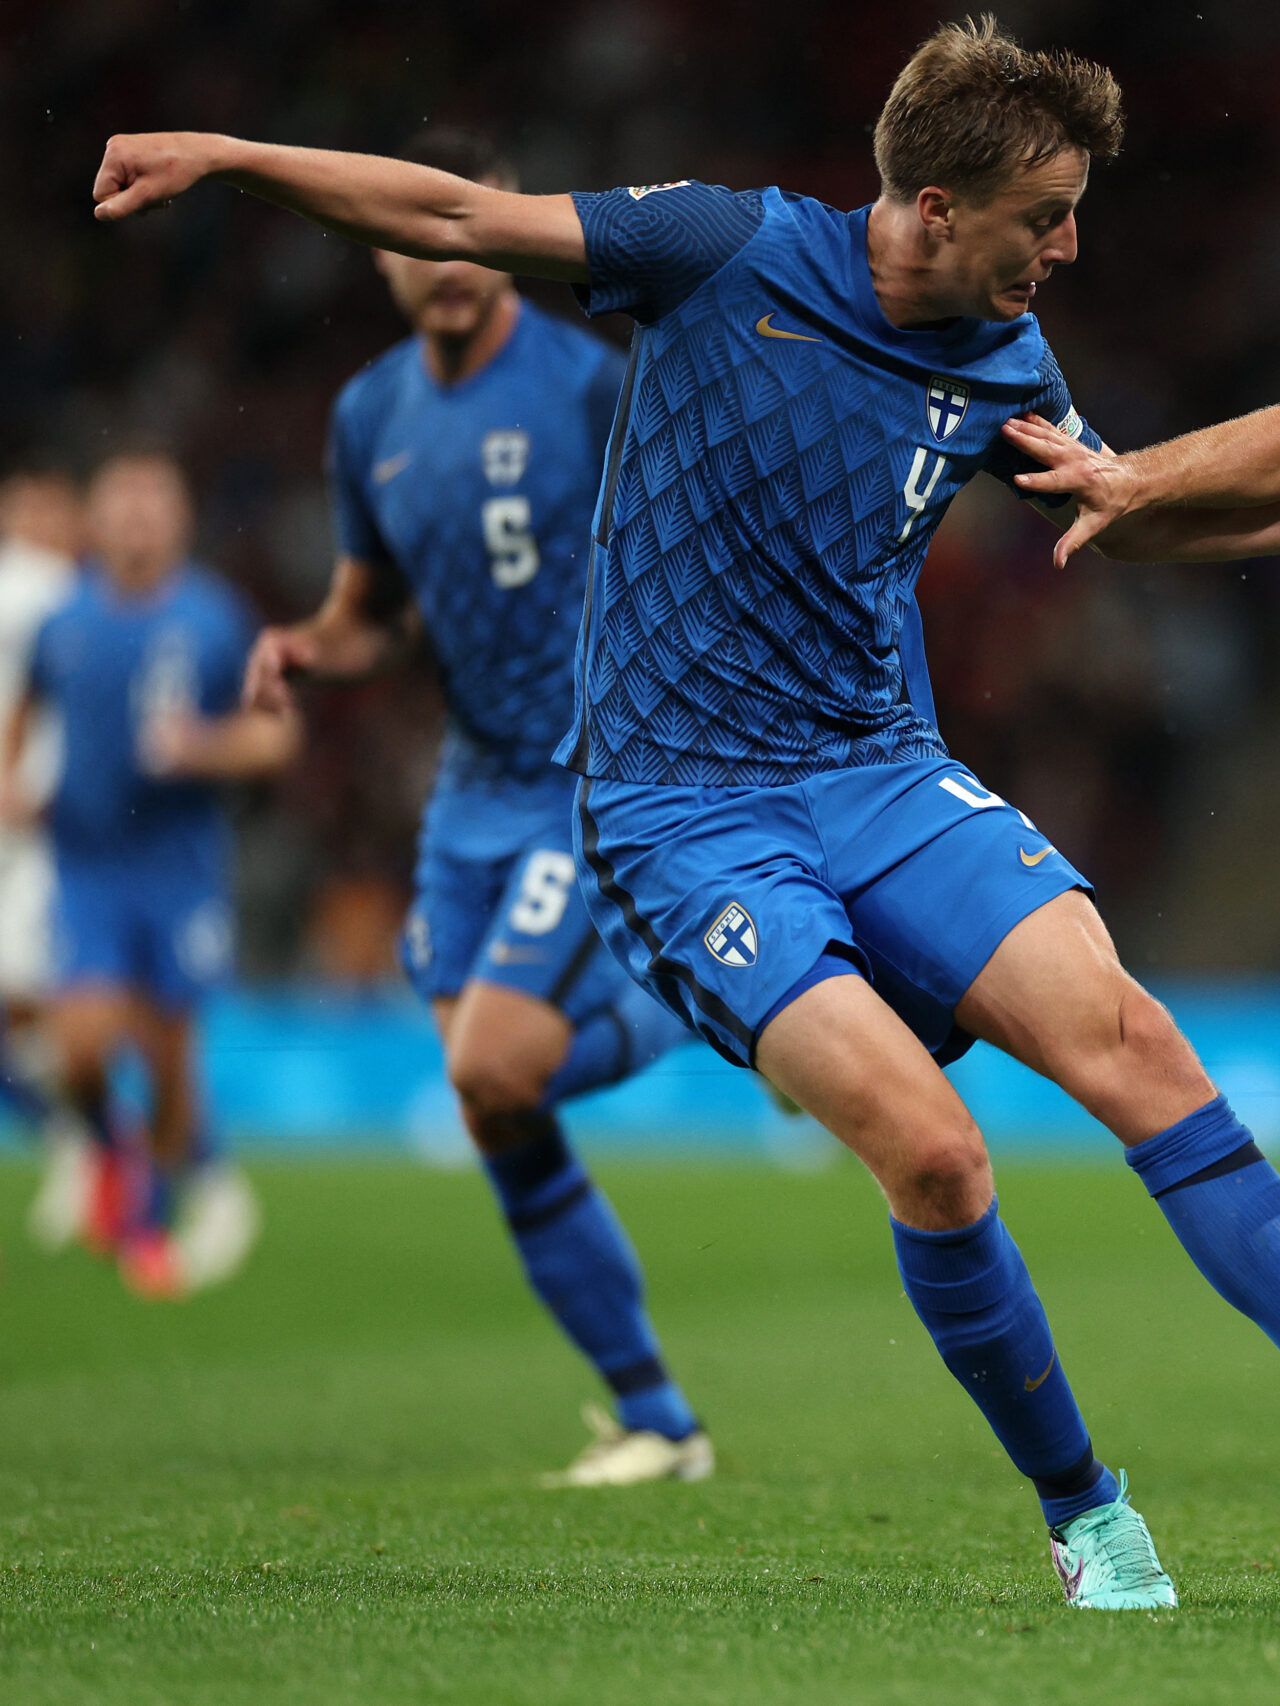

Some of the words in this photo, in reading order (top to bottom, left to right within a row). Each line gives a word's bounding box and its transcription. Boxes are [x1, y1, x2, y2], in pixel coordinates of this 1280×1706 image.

[897, 447, 946, 544] 4
[484, 496, 538, 588] 5
[510, 849, 575, 935] 5
[711, 911, 736, 940] SUOMI
